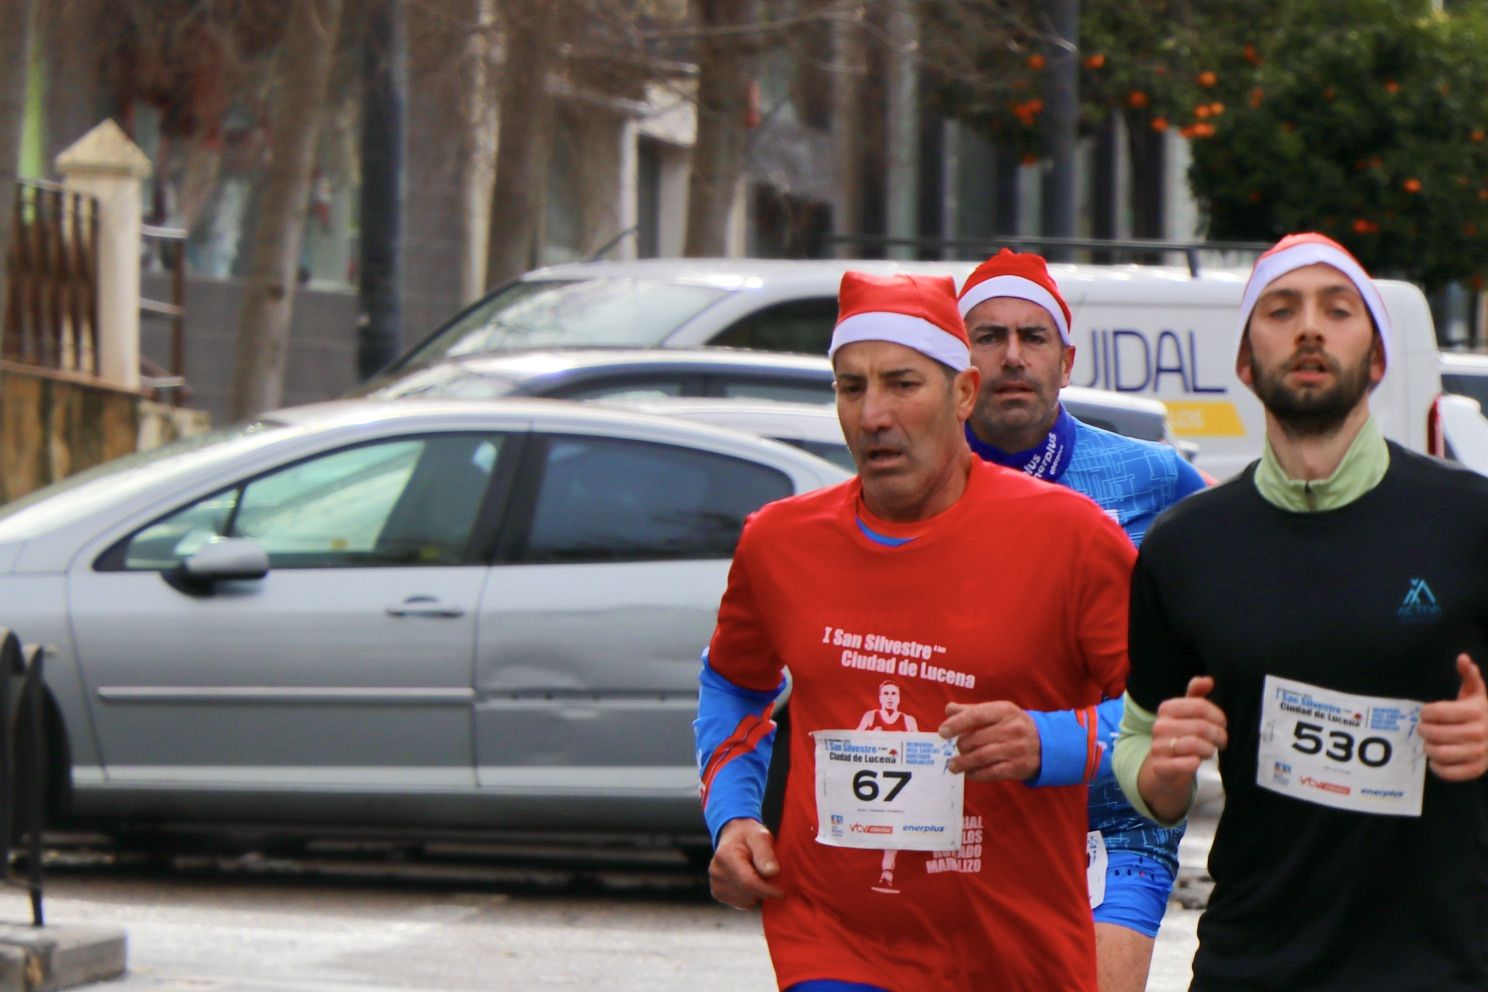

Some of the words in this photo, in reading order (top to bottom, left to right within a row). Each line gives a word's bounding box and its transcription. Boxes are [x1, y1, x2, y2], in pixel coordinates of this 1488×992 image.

[822, 626, 833, 644] I
[833, 628, 863, 649] San
[864, 633, 933, 660] Silvestre
[841, 650, 897, 674] Ciudad
[898, 659, 918, 677] de
[920, 662, 976, 689] Lucena
[829, 752, 852, 762] Ciudad
[852, 754, 863, 763] de
[864, 754, 897, 764] Lucena
[1292, 720, 1393, 768] 530
[852, 769, 913, 803] 67
[902, 824, 945, 834] enerplus
